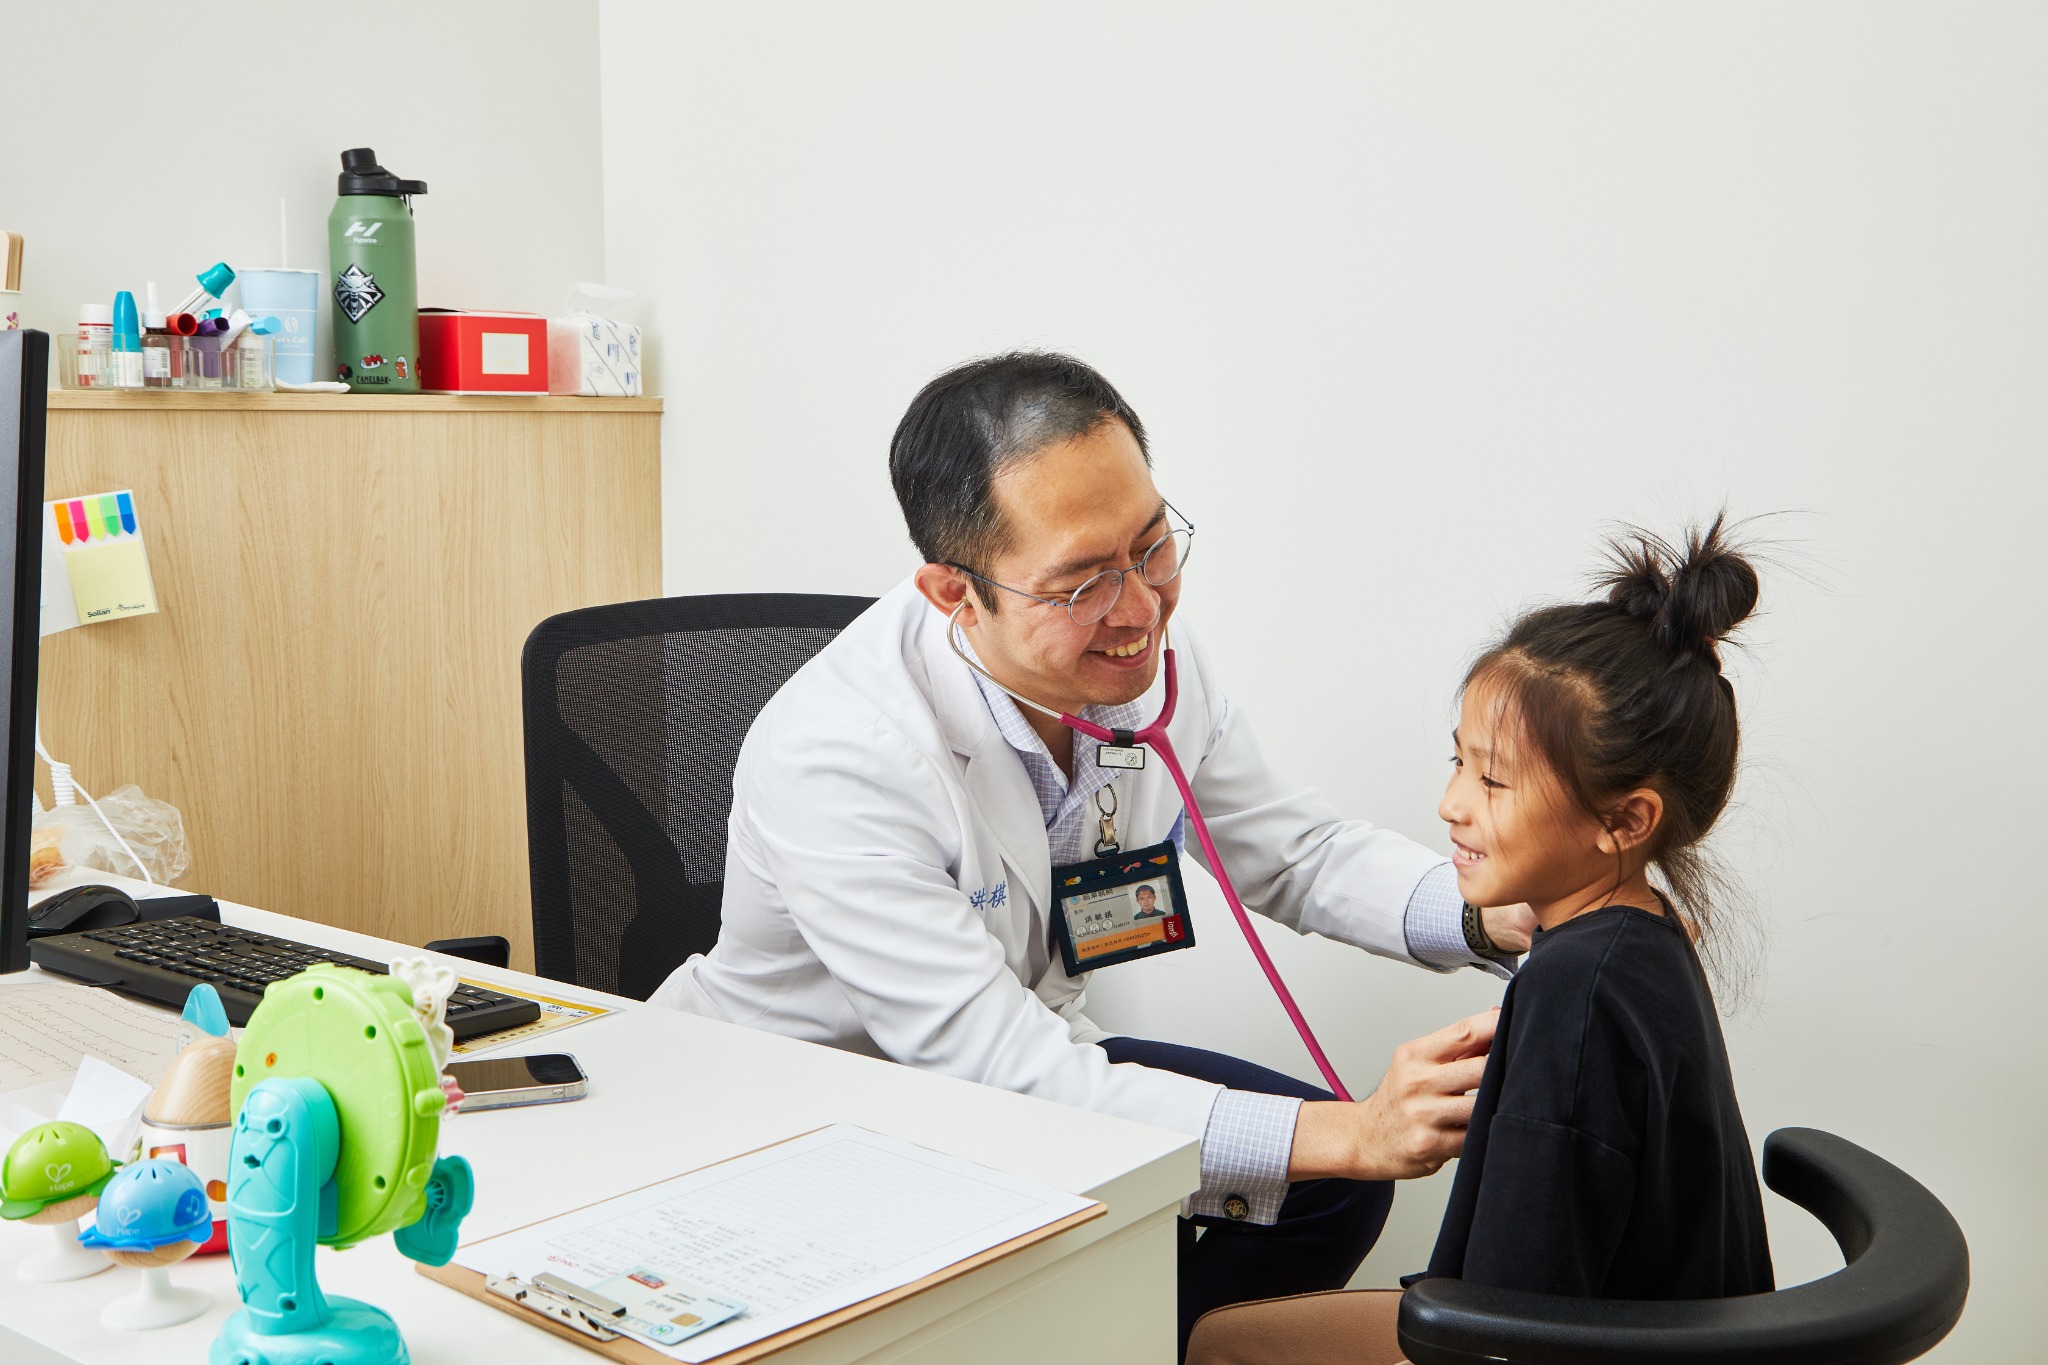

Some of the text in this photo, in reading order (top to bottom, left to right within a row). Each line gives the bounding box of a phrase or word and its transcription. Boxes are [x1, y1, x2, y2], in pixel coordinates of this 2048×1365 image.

[356, 375, 390, 385] CAMELBAK
[49, 1181, 75, 1193] Hape
[116, 1228, 141, 1237] Hape
